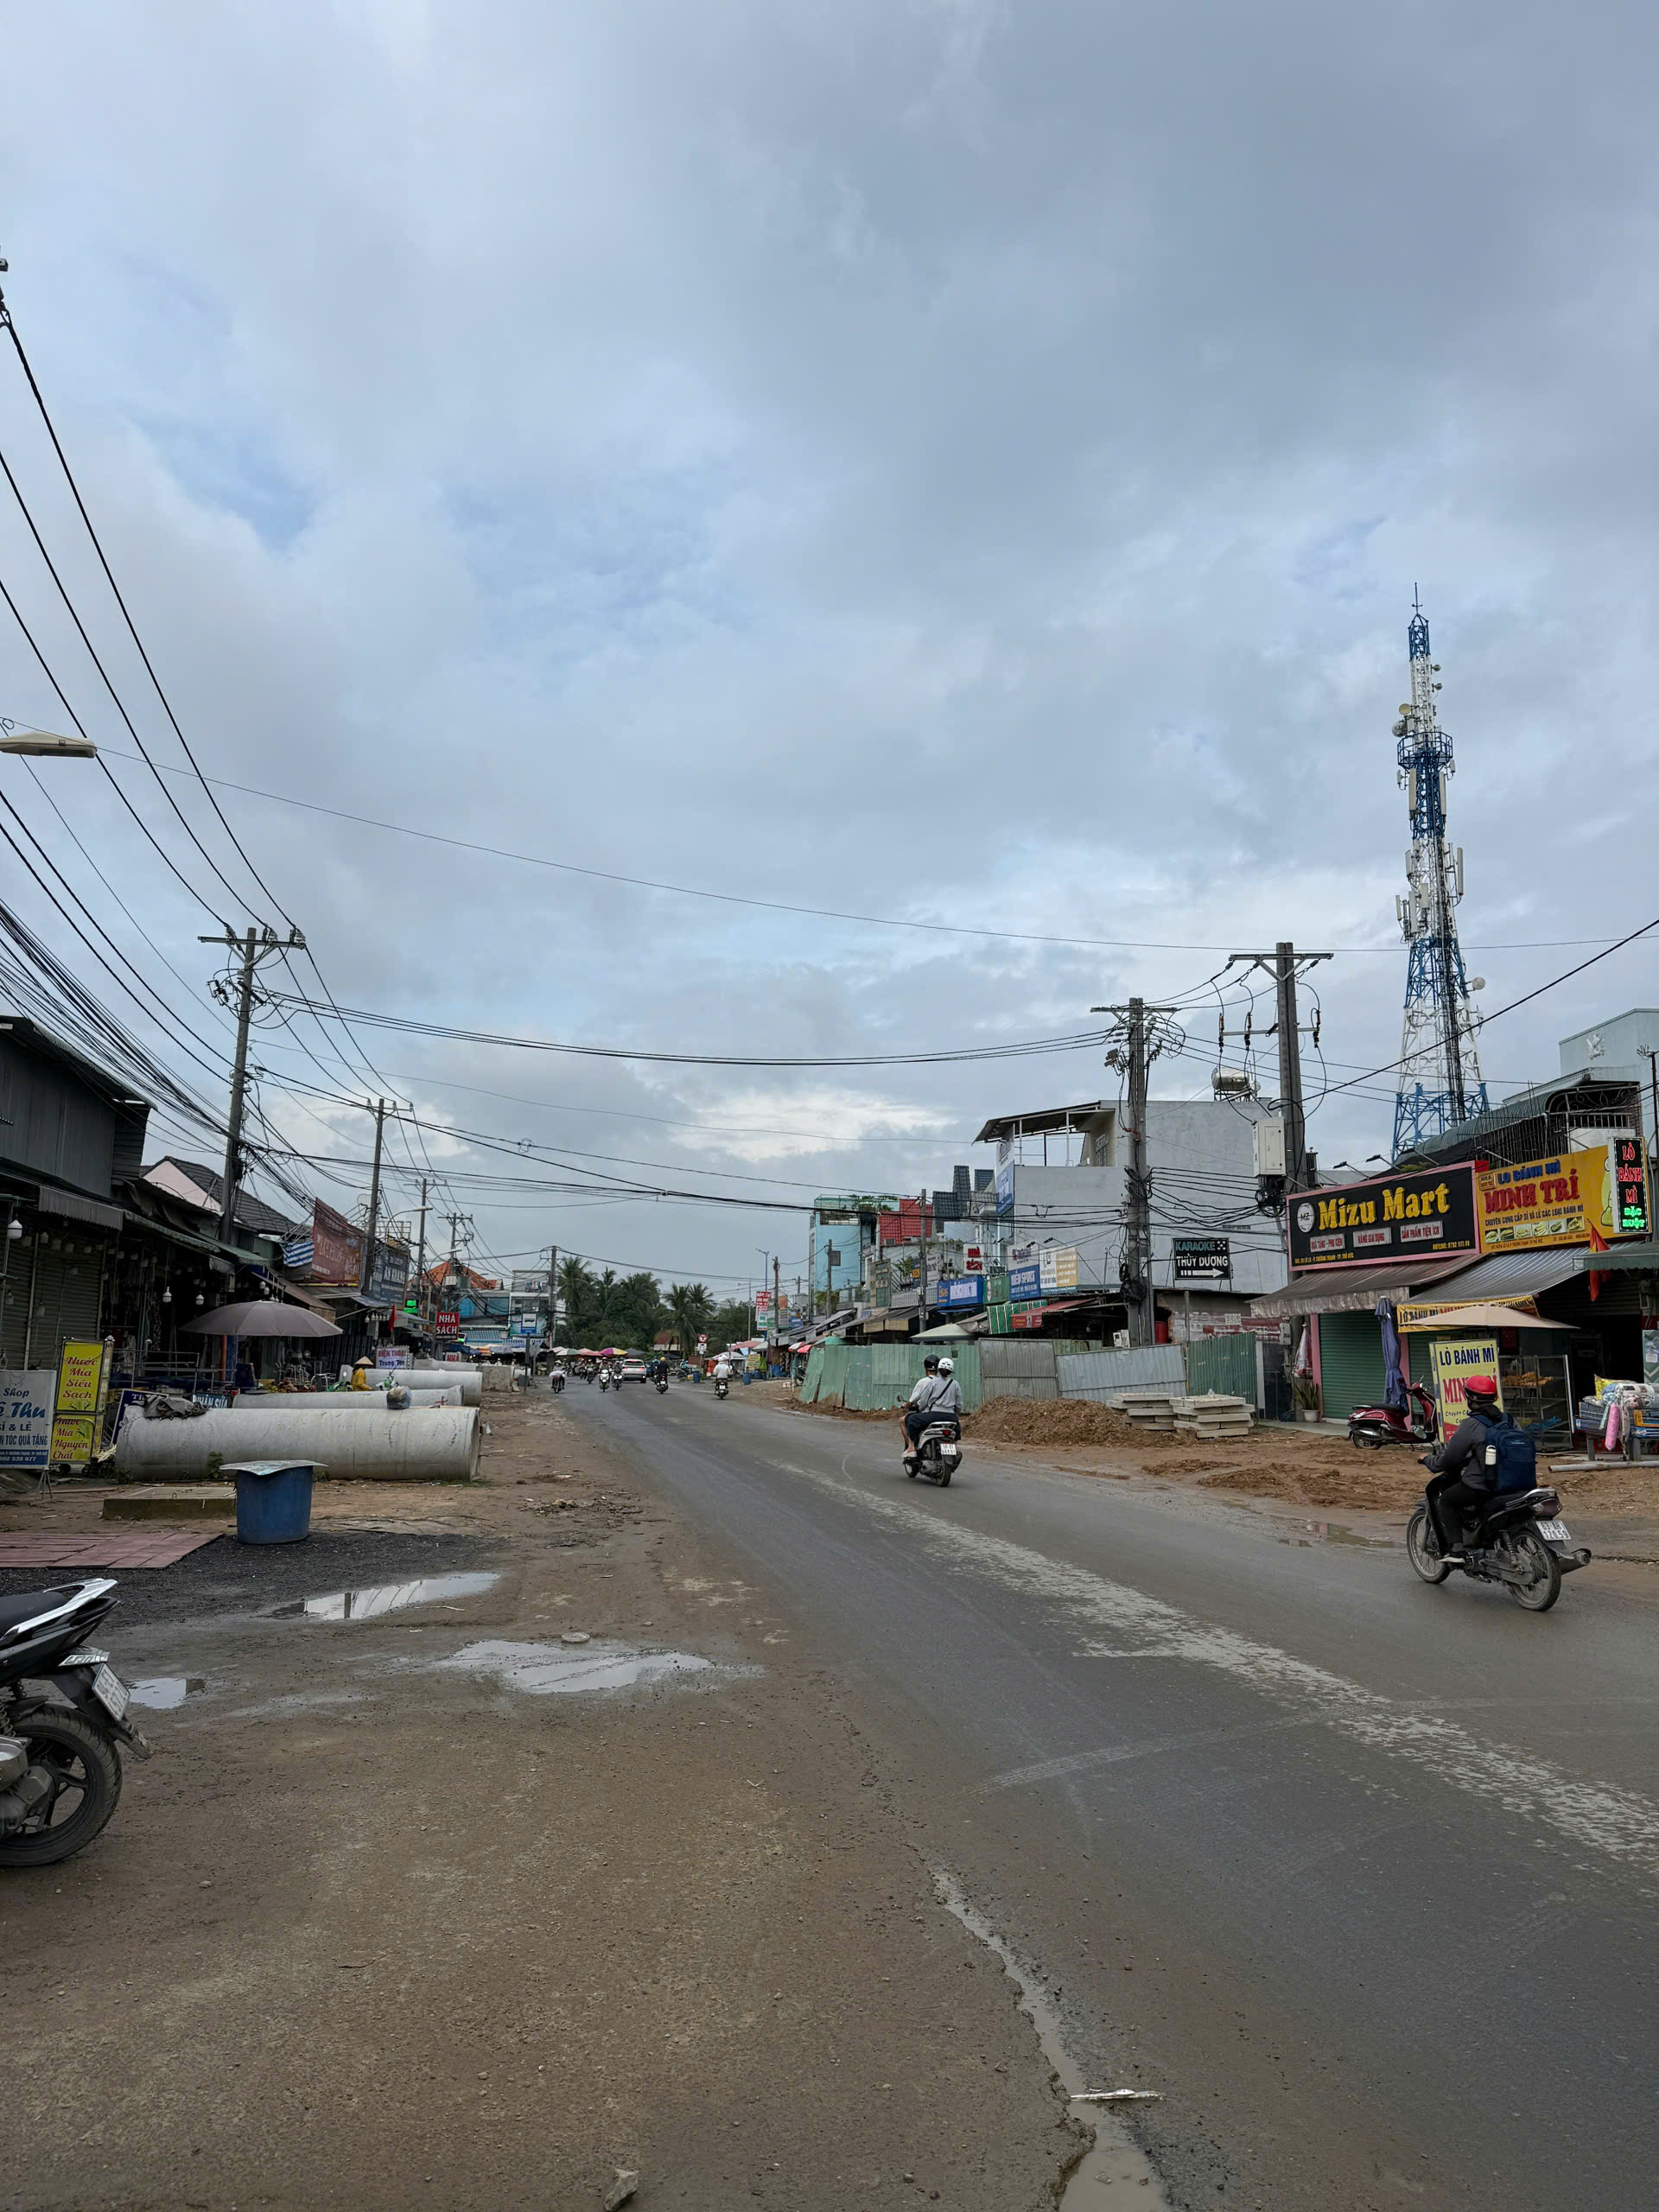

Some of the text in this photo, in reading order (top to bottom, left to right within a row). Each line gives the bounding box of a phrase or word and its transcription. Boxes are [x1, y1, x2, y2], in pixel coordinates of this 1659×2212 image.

[1622, 1141, 1636, 1160] LÒ
[1618, 1163, 1643, 1182] BÁNH
[1484, 1183, 1537, 1214] MINH
[1540, 1168, 1580, 1205] TRÍ
[1625, 1185, 1638, 1204] MÌ
[1318, 1198, 1377, 1230] Mizu
[1382, 1182, 1451, 1221] Mart
[1175, 1241, 1216, 1251] KARAOKE
[1176, 1253, 1197, 1267] THÙY
[439, 1313, 456, 1323] NHÀ
[436, 1325, 457, 1335] SÁCH
[1440, 1344, 1495, 1365] LÒ BÁNH MÌ
[67, 1357, 96, 1365] Nước
[69, 1368, 92, 1376] Mía
[66, 1378, 92, 1388] Siêu
[3, 1388, 29, 1399] Shop
[62, 1390, 92, 1399] Sạch
[10, 1402, 46, 1418] Thu
[20, 1421, 32, 1431] LẺ
[56, 1427, 73, 1437] Mía
[6, 1433, 16, 1445] TÓC
[18, 1433, 30, 1446] QUÀ
[32, 1434, 48, 1447] TẶNG
[54, 1440, 88, 1451] Nguyên
